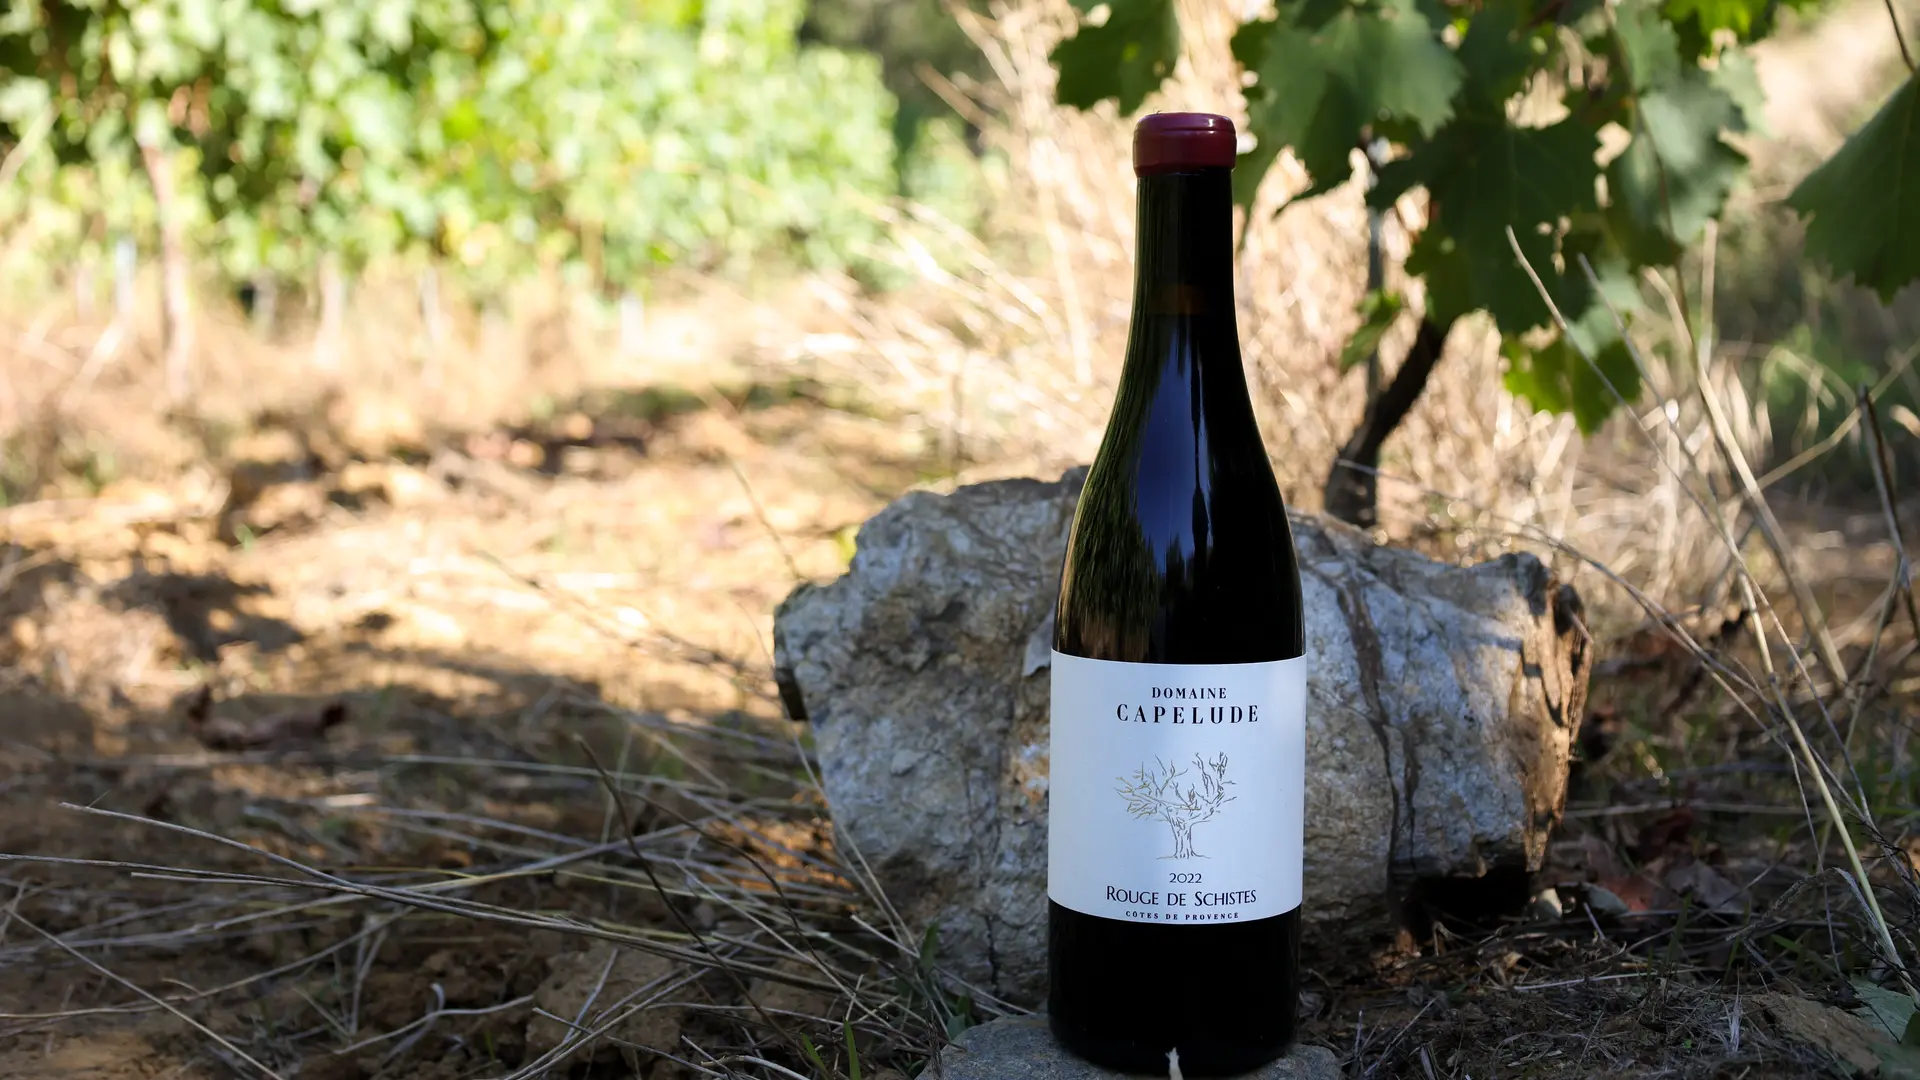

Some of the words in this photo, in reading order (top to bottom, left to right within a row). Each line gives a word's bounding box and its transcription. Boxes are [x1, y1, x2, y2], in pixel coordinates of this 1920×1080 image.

[1152, 687, 1227, 699] DOMAINE
[1116, 703, 1259, 725] CAPELUDE
[1169, 872, 1202, 884] 2022
[1167, 892, 1187, 906] DE
[1125, 910, 1159, 920] CÔTES
[1185, 912, 1239, 921] PROVENCE
